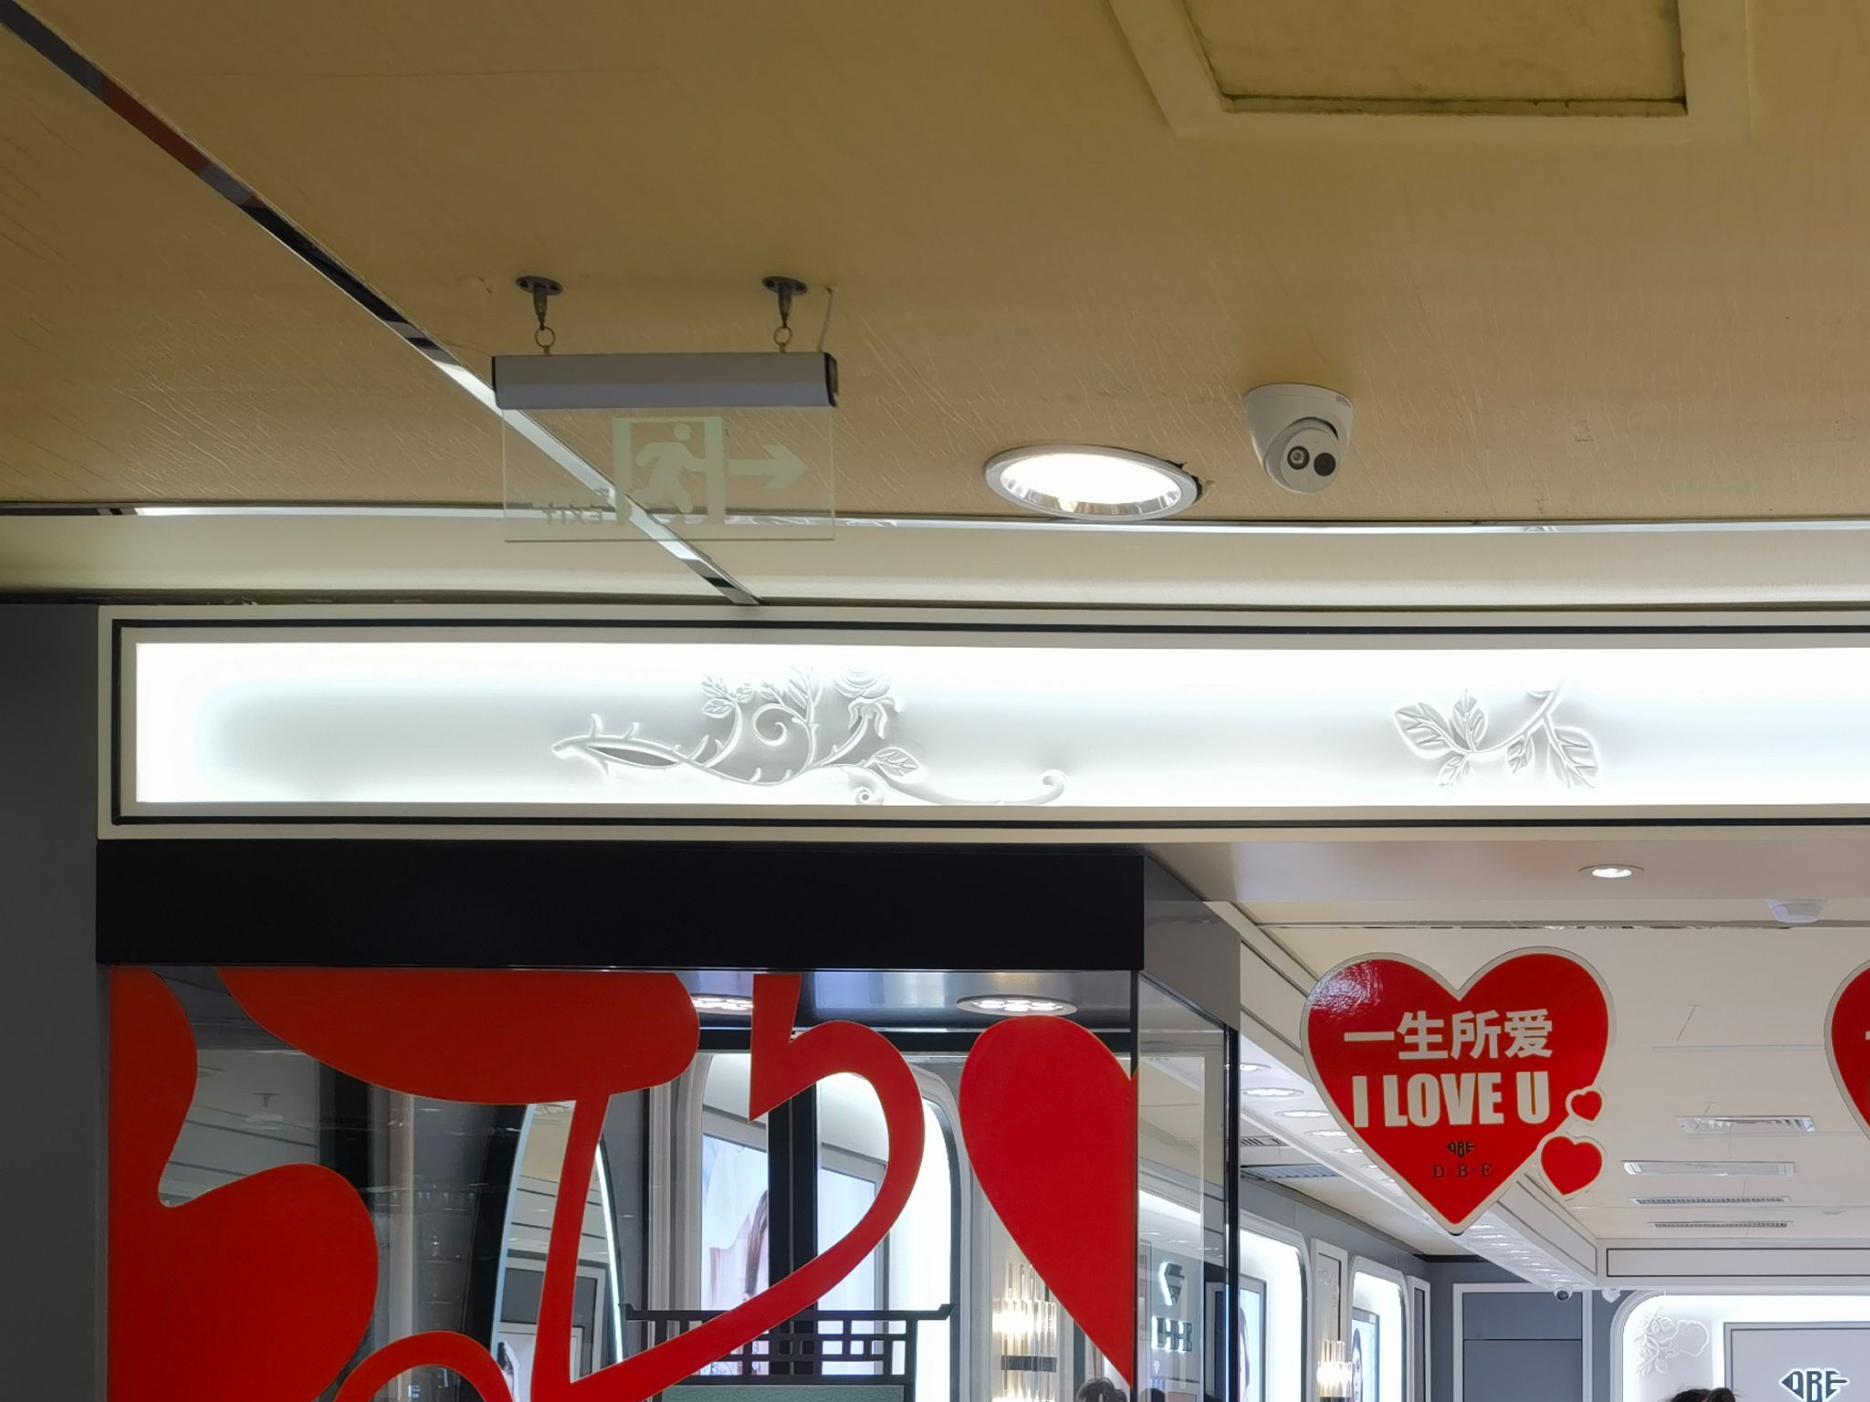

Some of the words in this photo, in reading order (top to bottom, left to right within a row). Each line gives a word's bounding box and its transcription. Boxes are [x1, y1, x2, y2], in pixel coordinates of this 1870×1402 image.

[1344, 1009, 1552, 1060] 一生所爱
[1352, 1075, 1369, 1128] I
[1383, 1072, 1504, 1127] LOVE
[1516, 1071, 1550, 1124] U
